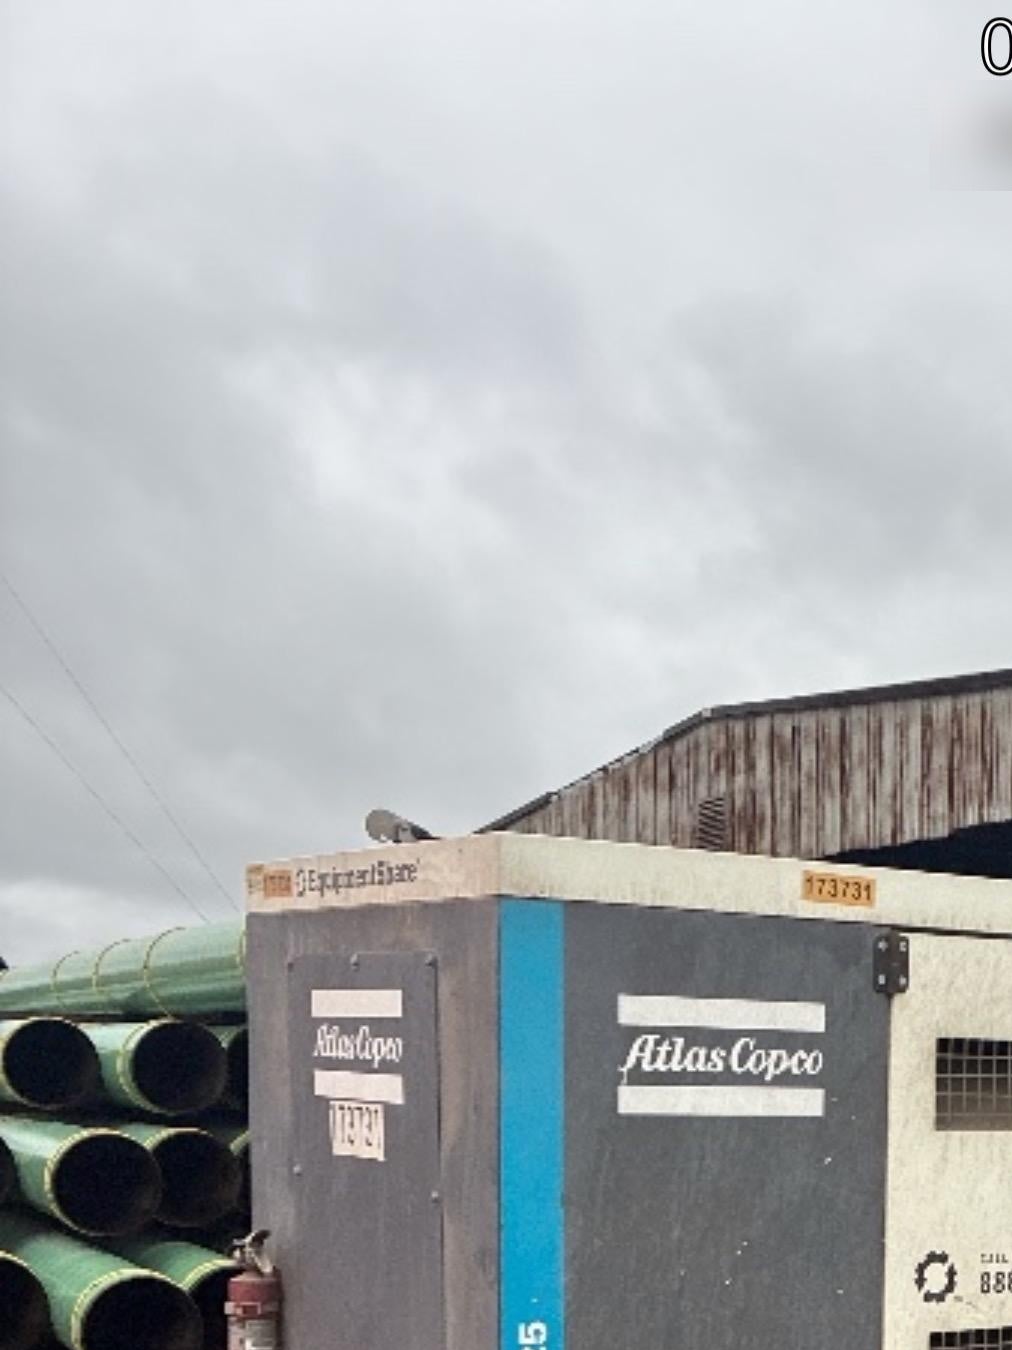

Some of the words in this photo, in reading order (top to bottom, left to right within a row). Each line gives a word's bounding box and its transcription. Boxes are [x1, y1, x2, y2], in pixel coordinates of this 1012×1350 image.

[806, 874, 872, 901] 173731
[313, 1023, 355, 1061] Atlas
[356, 1025, 403, 1068] Copco
[618, 1033, 726, 1084] Atlas
[730, 1036, 824, 1081] Copco
